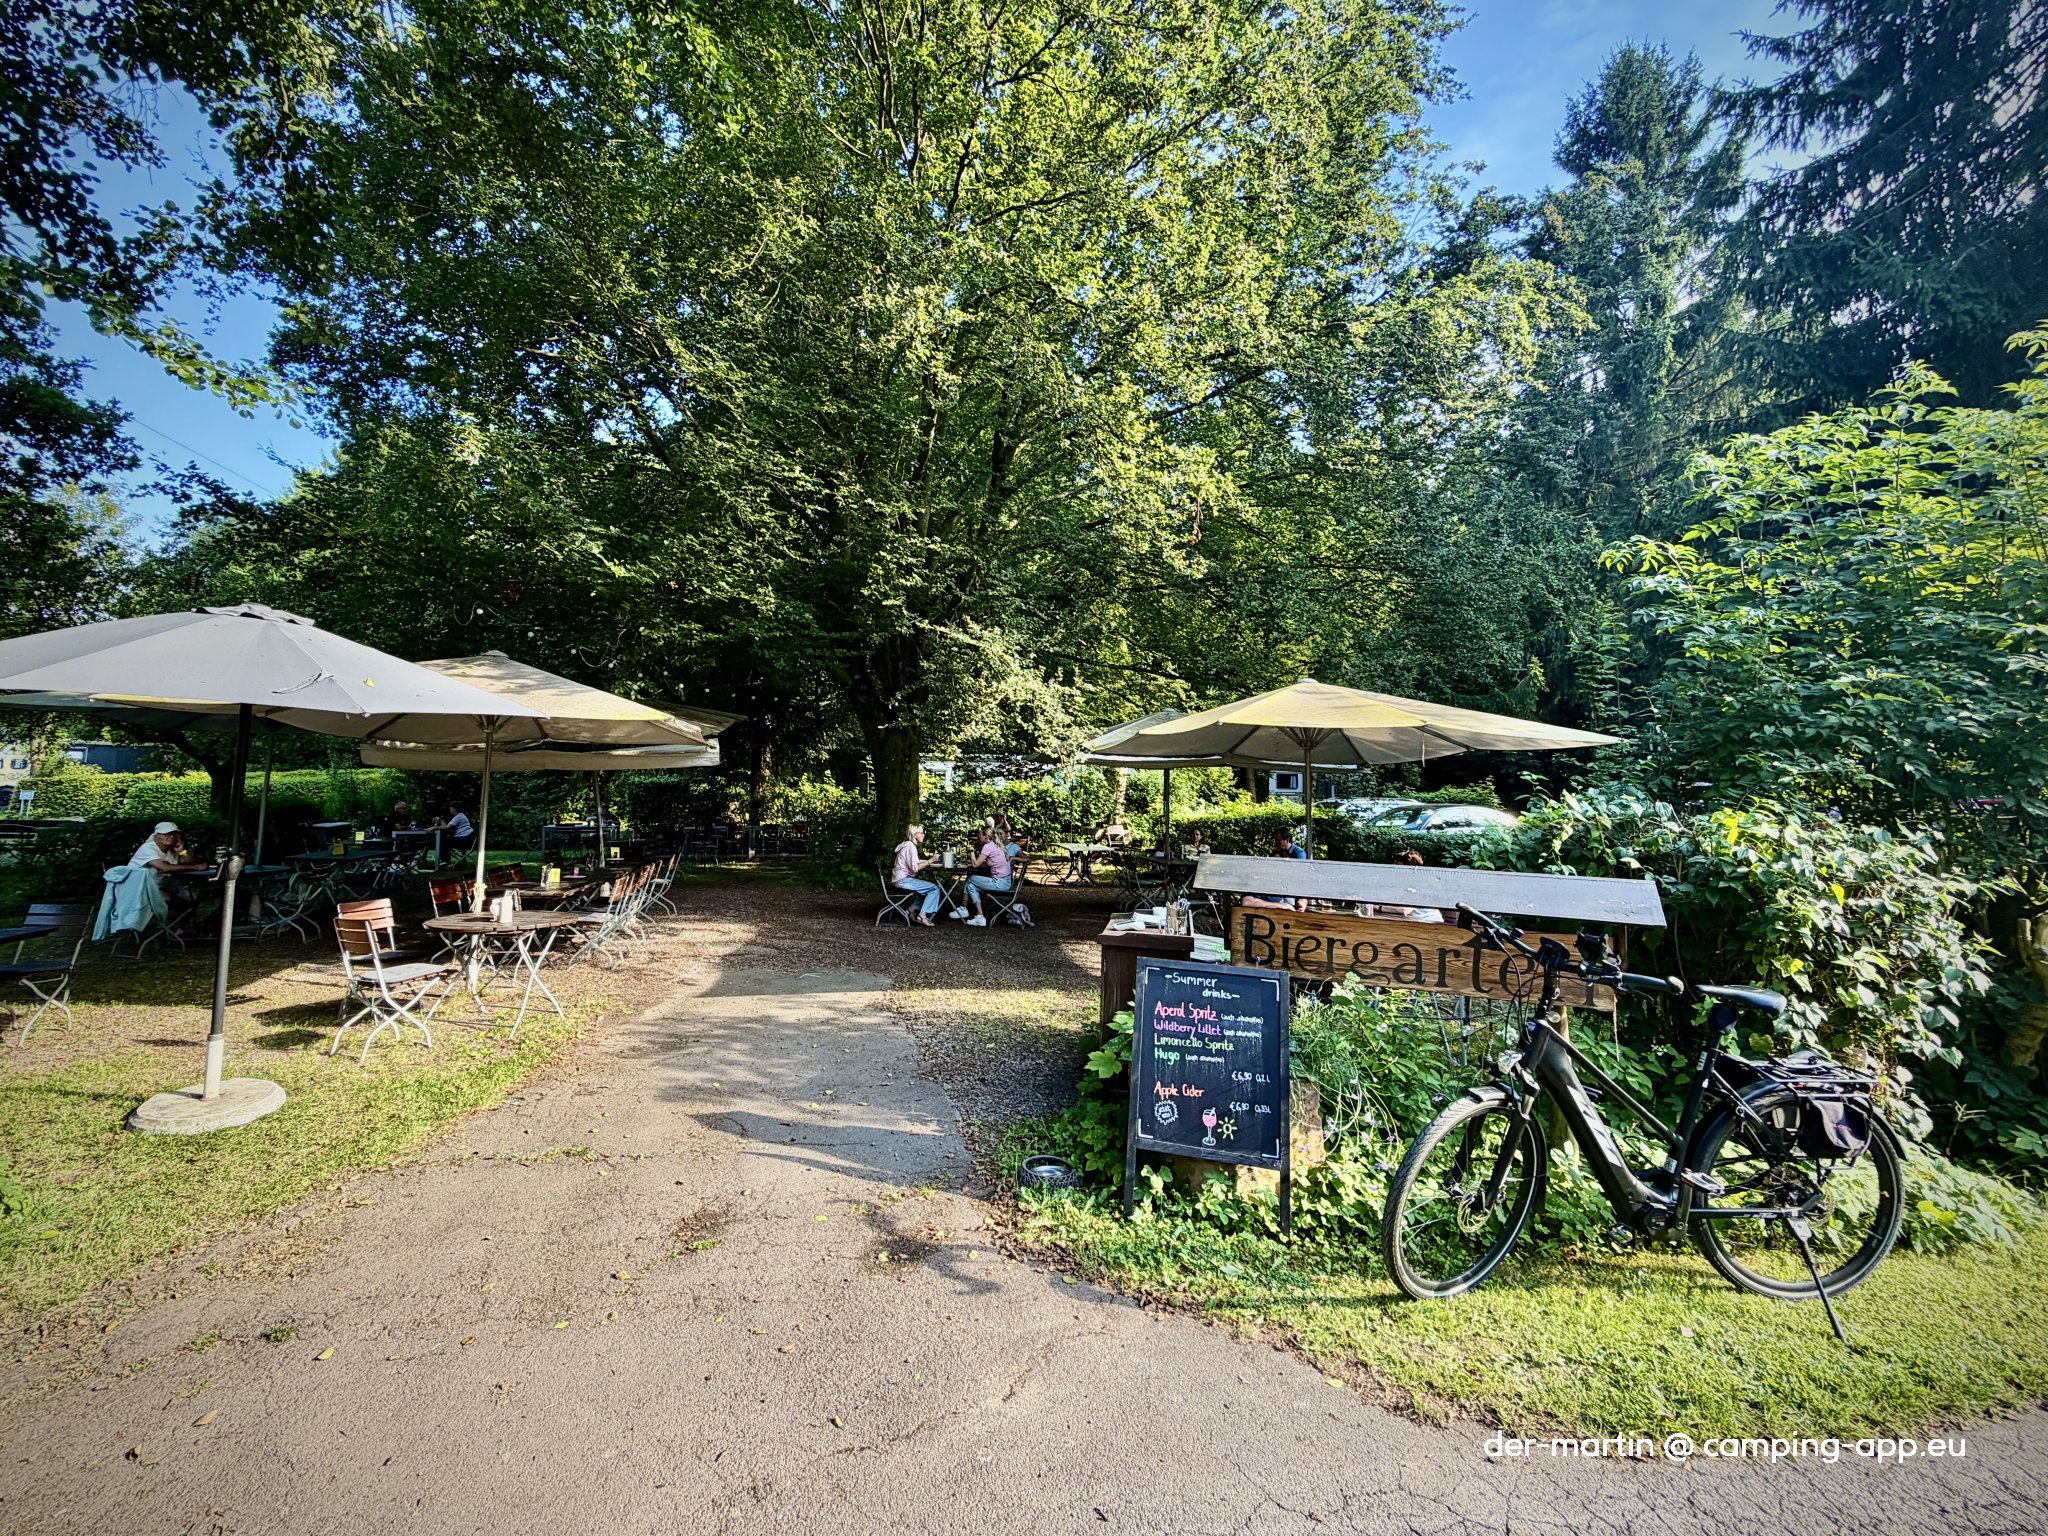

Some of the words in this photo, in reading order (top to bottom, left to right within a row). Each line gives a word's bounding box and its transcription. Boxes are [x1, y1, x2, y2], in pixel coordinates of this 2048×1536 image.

[1154, 1000, 1186, 1019] Aperol
[1188, 1002, 1219, 1024] Spritz
[1154, 1018, 1196, 1040] Wildberry
[1198, 1023, 1222, 1036] Lillet
[1154, 1032, 1203, 1048] Limoncello
[1204, 1037, 1235, 1054] Spritz
[1154, 1046, 1180, 1065] Hugo
[1153, 1080, 1180, 1100] Apple
[1182, 1083, 1205, 1098] Cider
